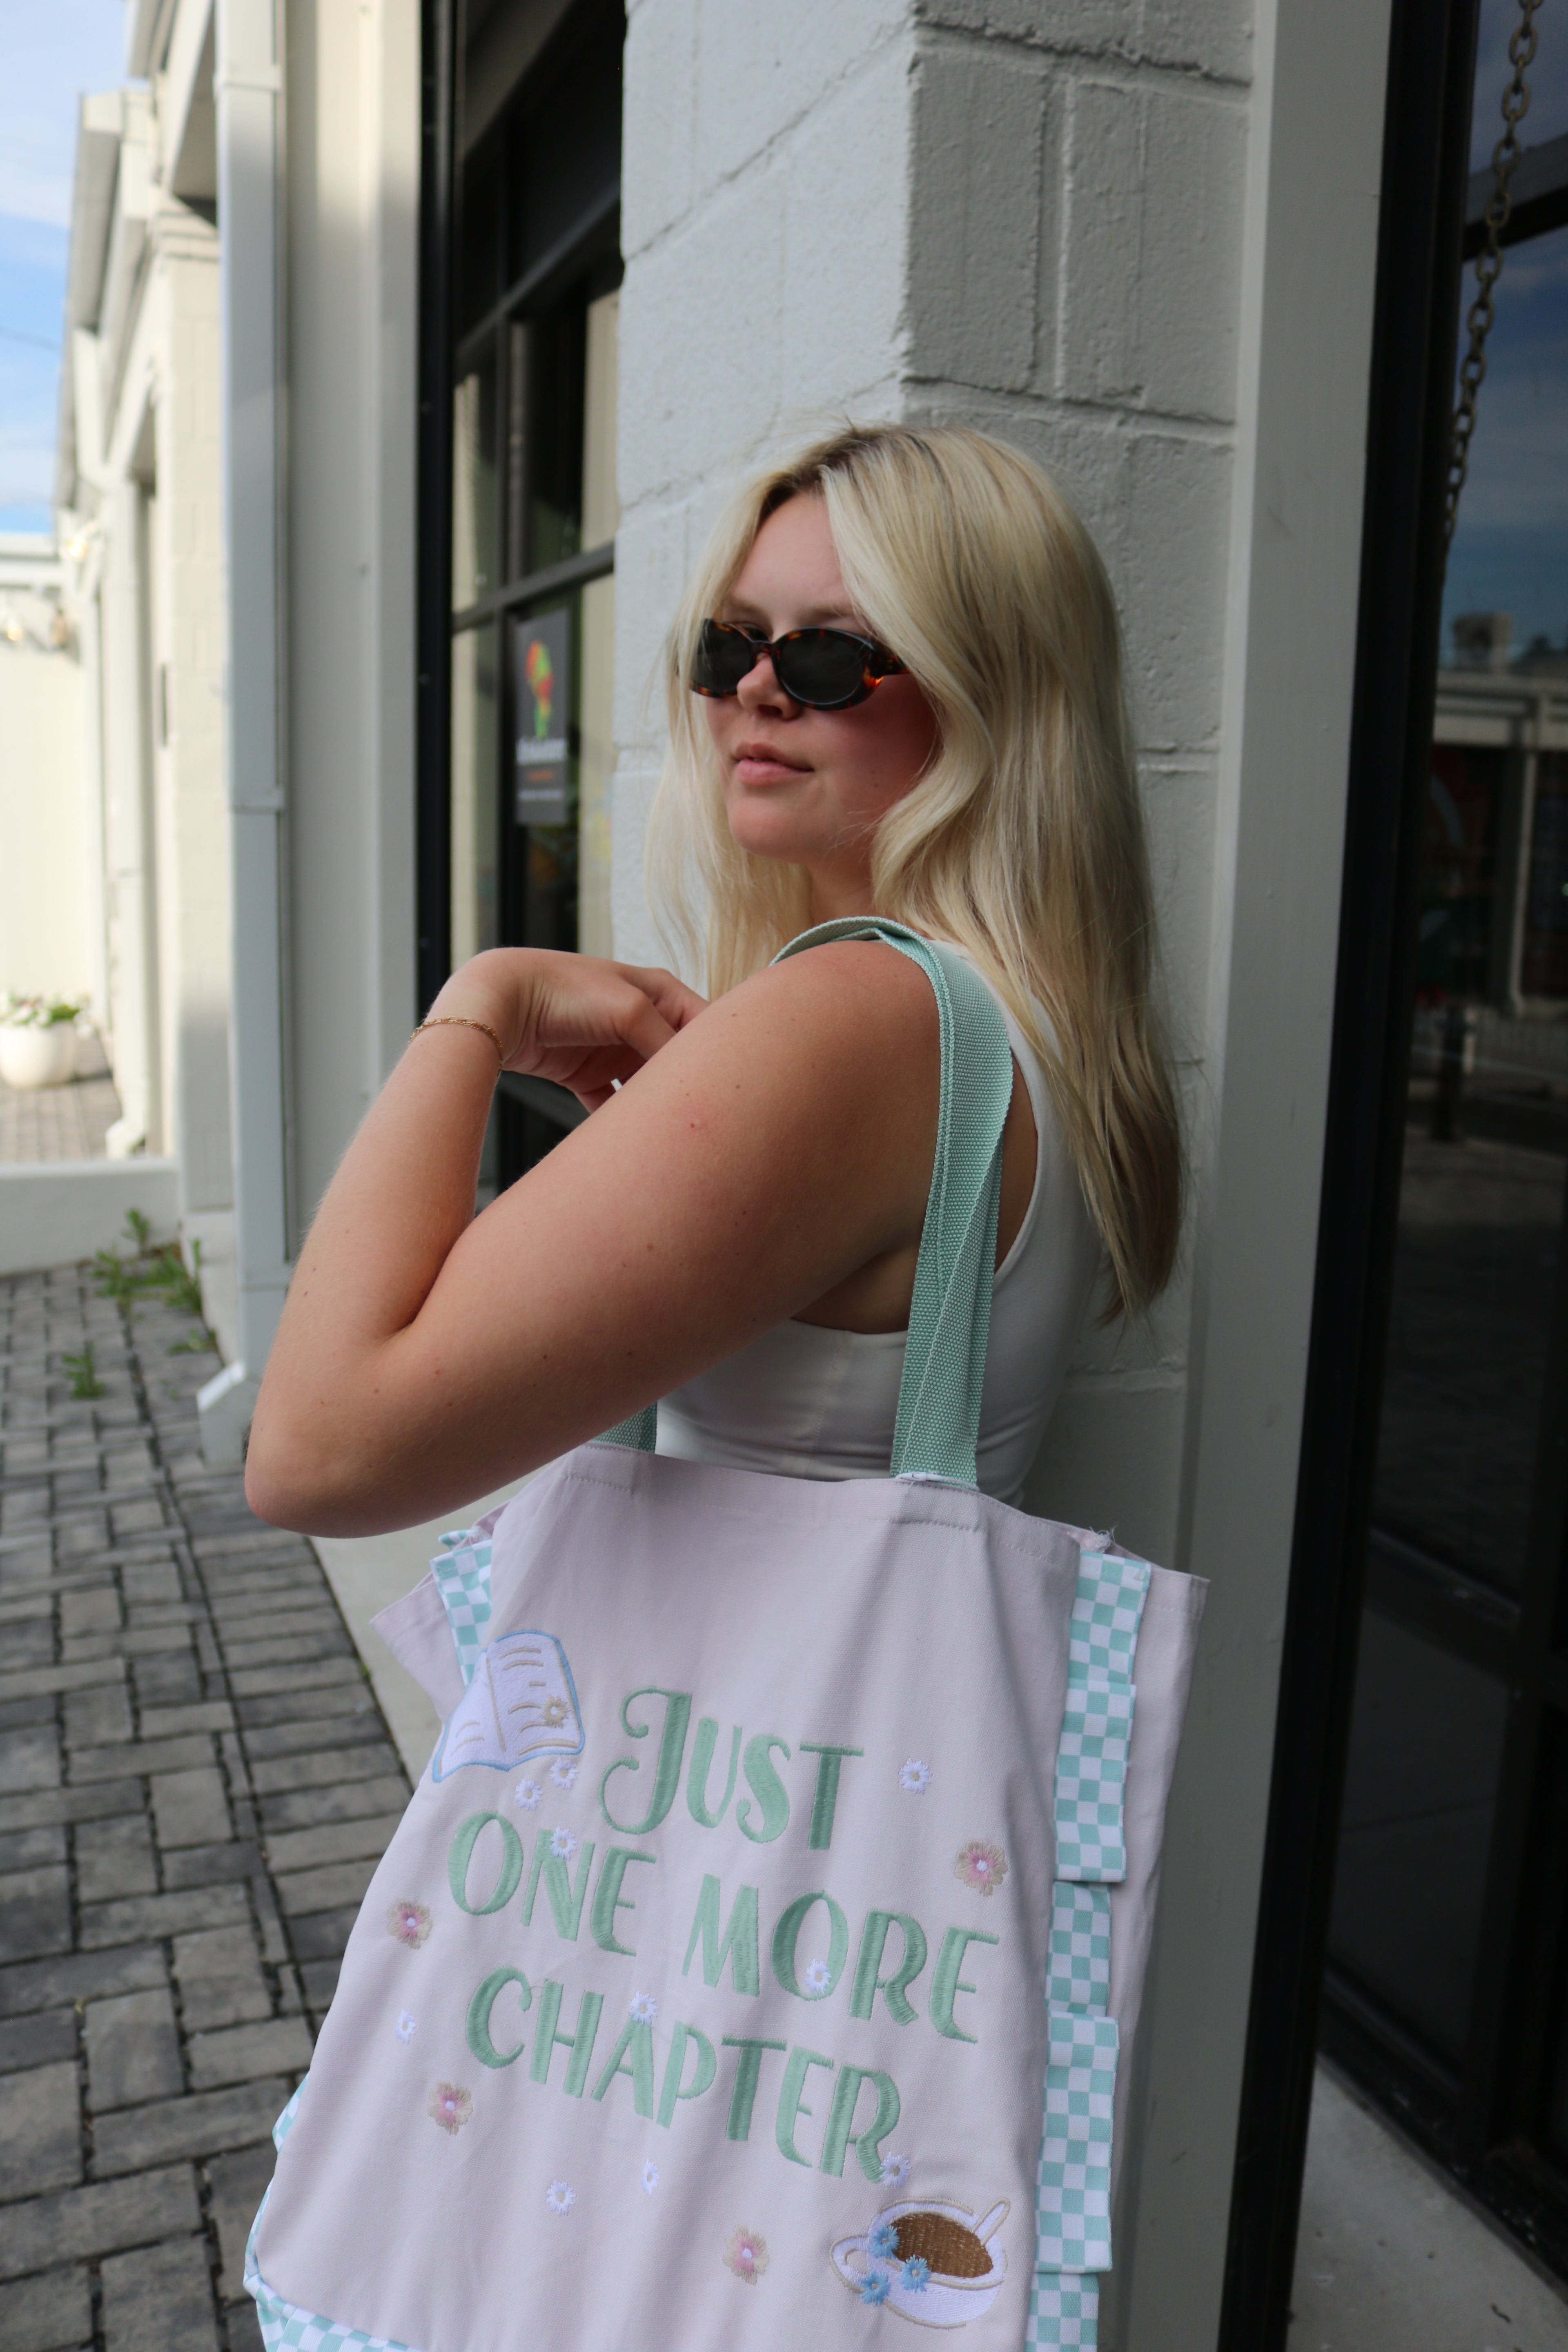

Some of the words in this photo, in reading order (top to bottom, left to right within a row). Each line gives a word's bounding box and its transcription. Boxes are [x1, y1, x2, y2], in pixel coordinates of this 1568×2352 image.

[599, 1686, 863, 1850] JUST
[448, 1811, 657, 1956] ONE
[682, 1874, 999, 2043] MORE
[466, 1967, 901, 2183] CHAPTER
